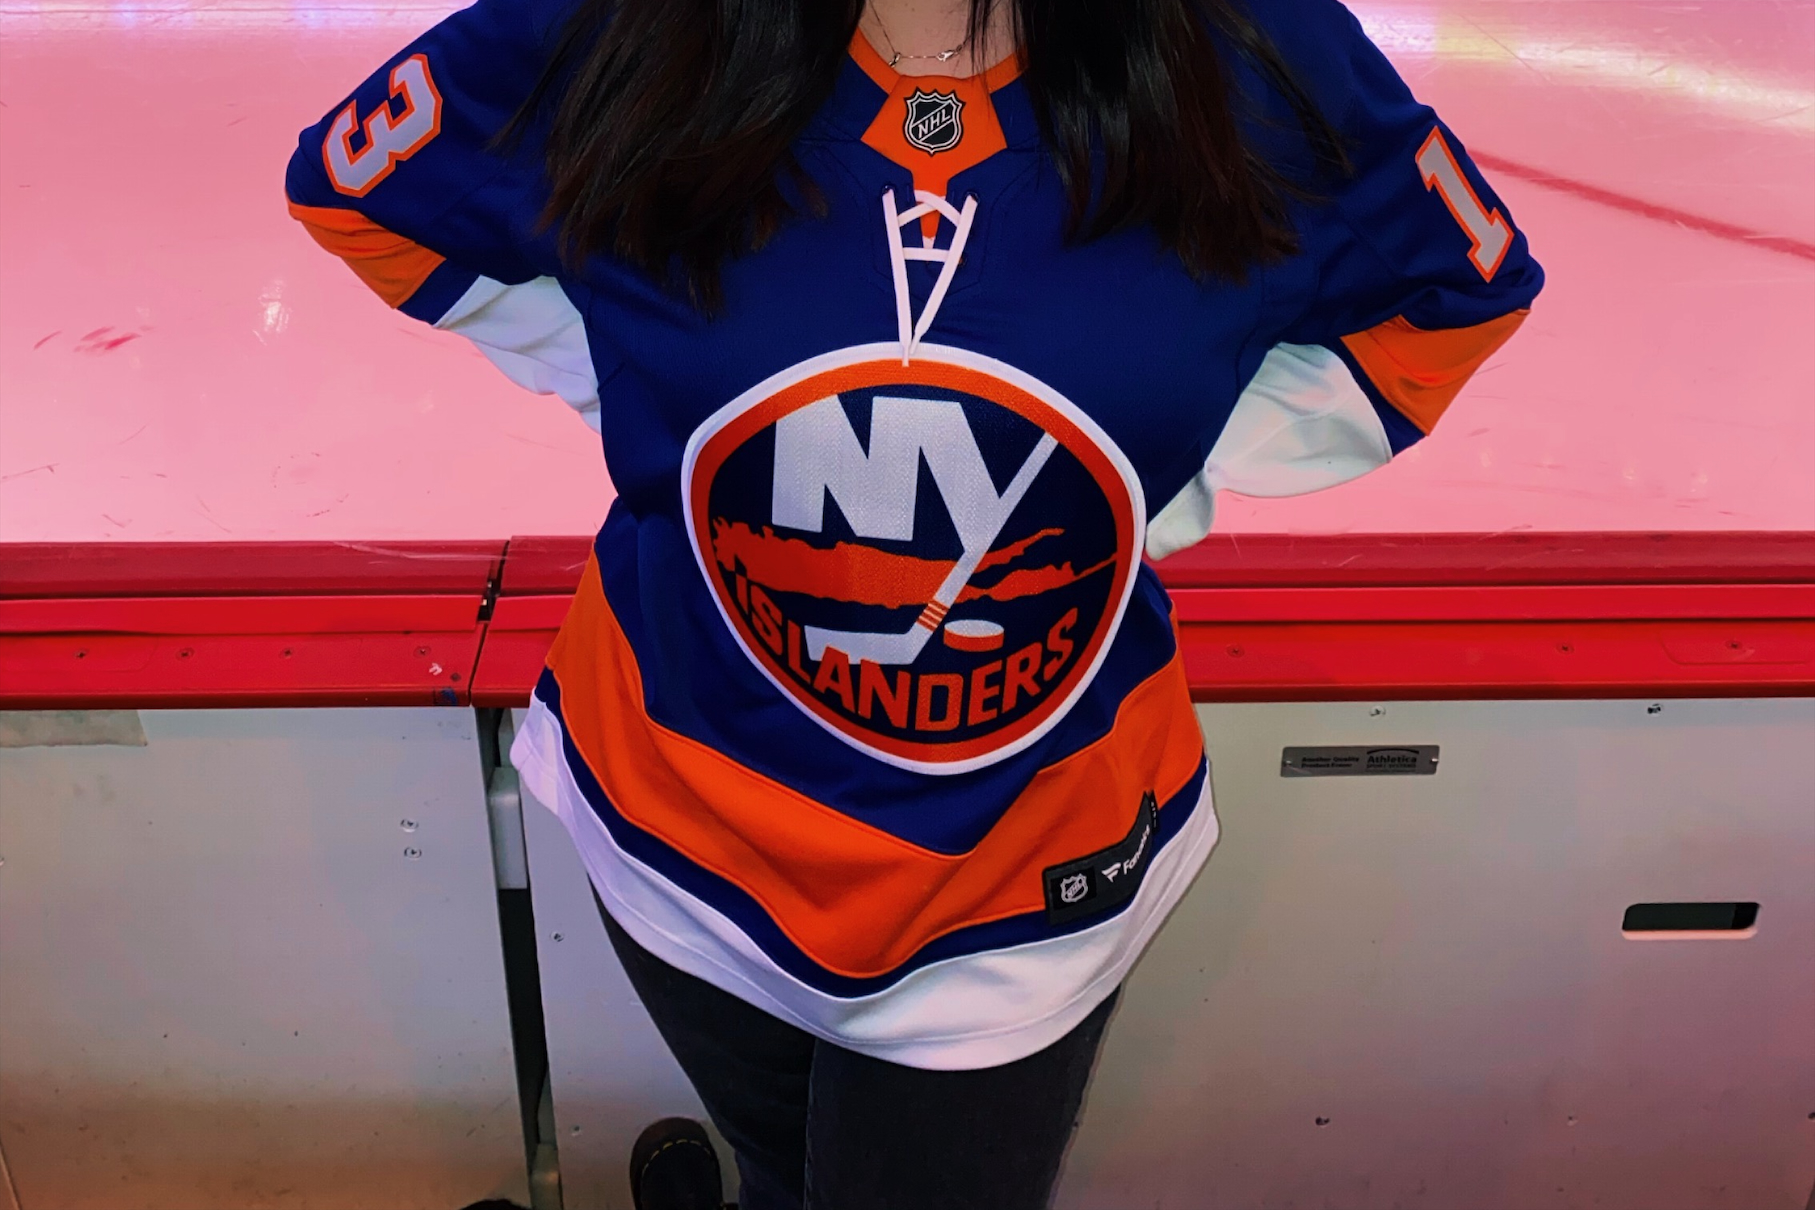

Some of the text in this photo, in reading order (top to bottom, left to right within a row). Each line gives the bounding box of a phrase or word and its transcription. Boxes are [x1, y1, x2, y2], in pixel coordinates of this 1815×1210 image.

[322, 53, 443, 198] 3
[918, 108, 951, 139] NHL
[1415, 125, 1514, 283] 1
[772, 394, 1059, 568] NY
[733, 571, 1079, 732] ISLANDERS
[1367, 754, 1418, 764] Athletica
